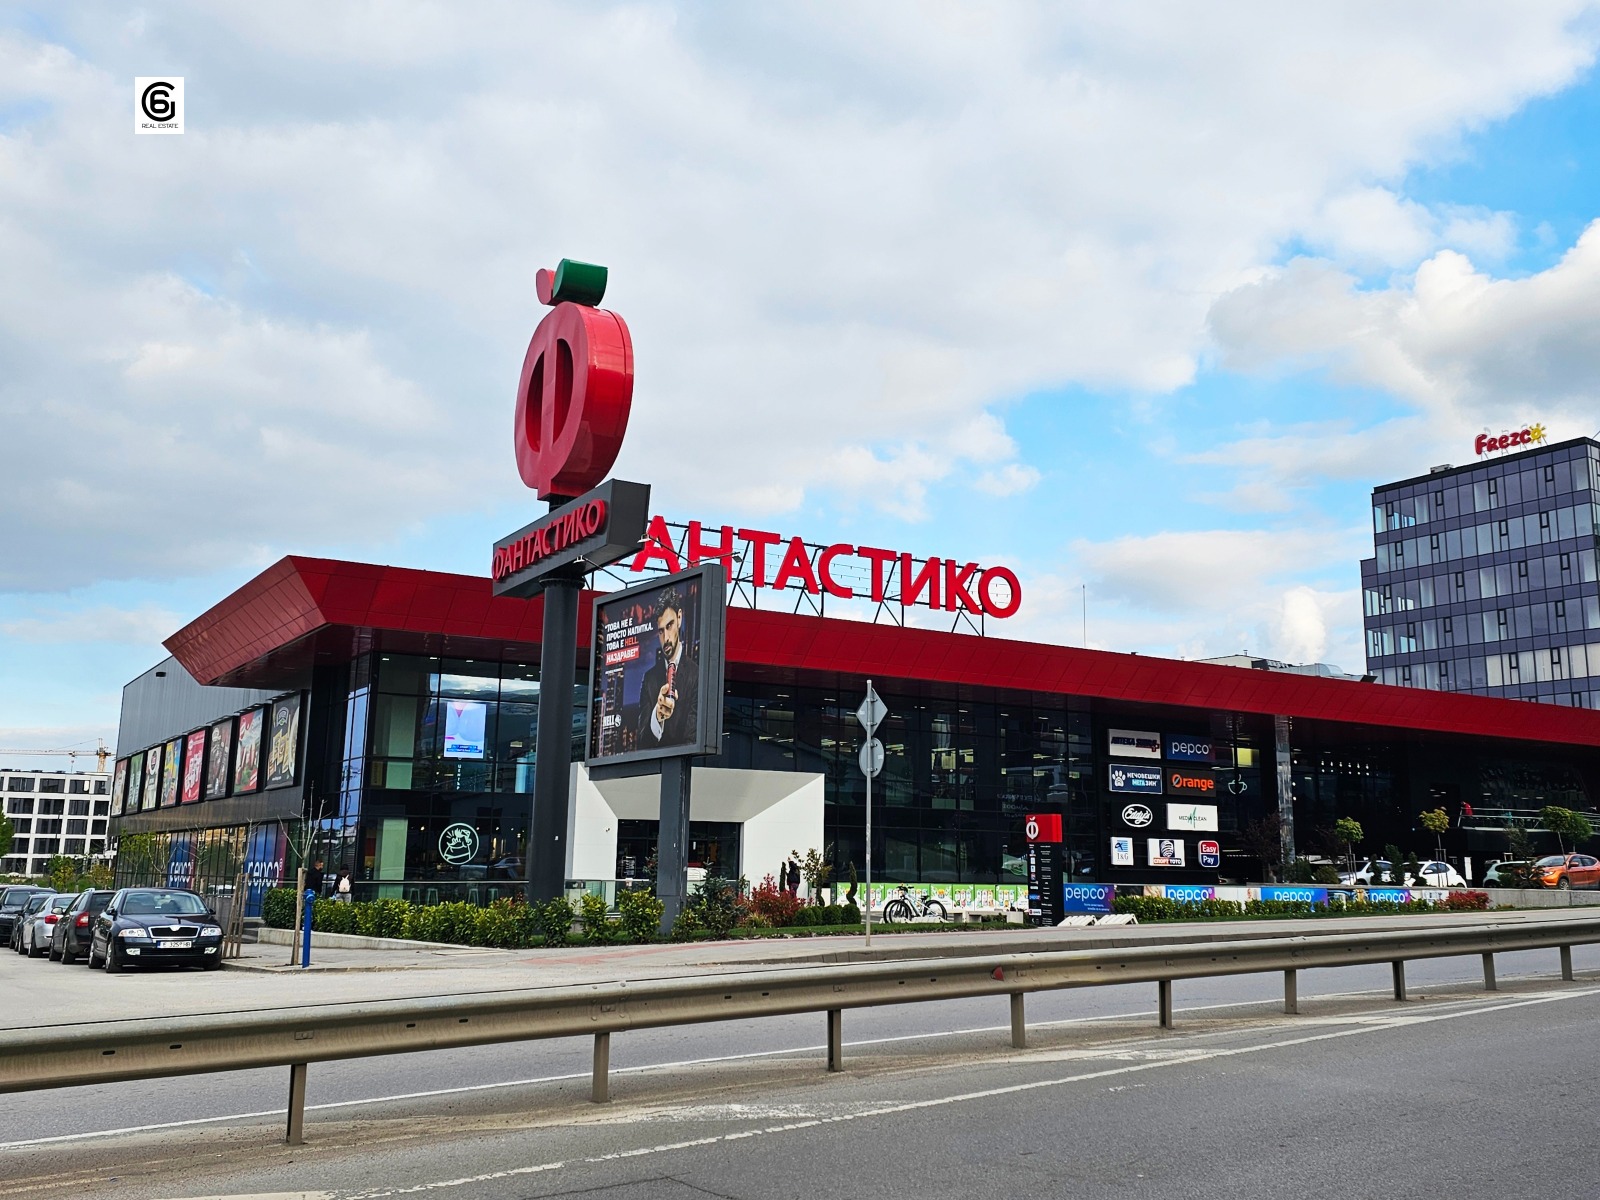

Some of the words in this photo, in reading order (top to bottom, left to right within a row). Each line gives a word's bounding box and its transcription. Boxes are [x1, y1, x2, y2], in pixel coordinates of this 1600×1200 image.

[492, 499, 606, 581] ФАНТАСТИКО
[629, 515, 1021, 619] АНТАСТИКО
[621, 619, 628, 628] НЕ
[629, 618, 633, 626] Е
[606, 629, 626, 642] ПРОСТО
[606, 641, 619, 652] ТОВА
[620, 639, 624, 648] Е
[1172, 742, 1209, 756] pepco
[1172, 774, 1214, 791] Orange
[1202, 844, 1217, 854] Easy
[1203, 855, 1215, 865] Pay
[1065, 887, 1105, 902] pepco
